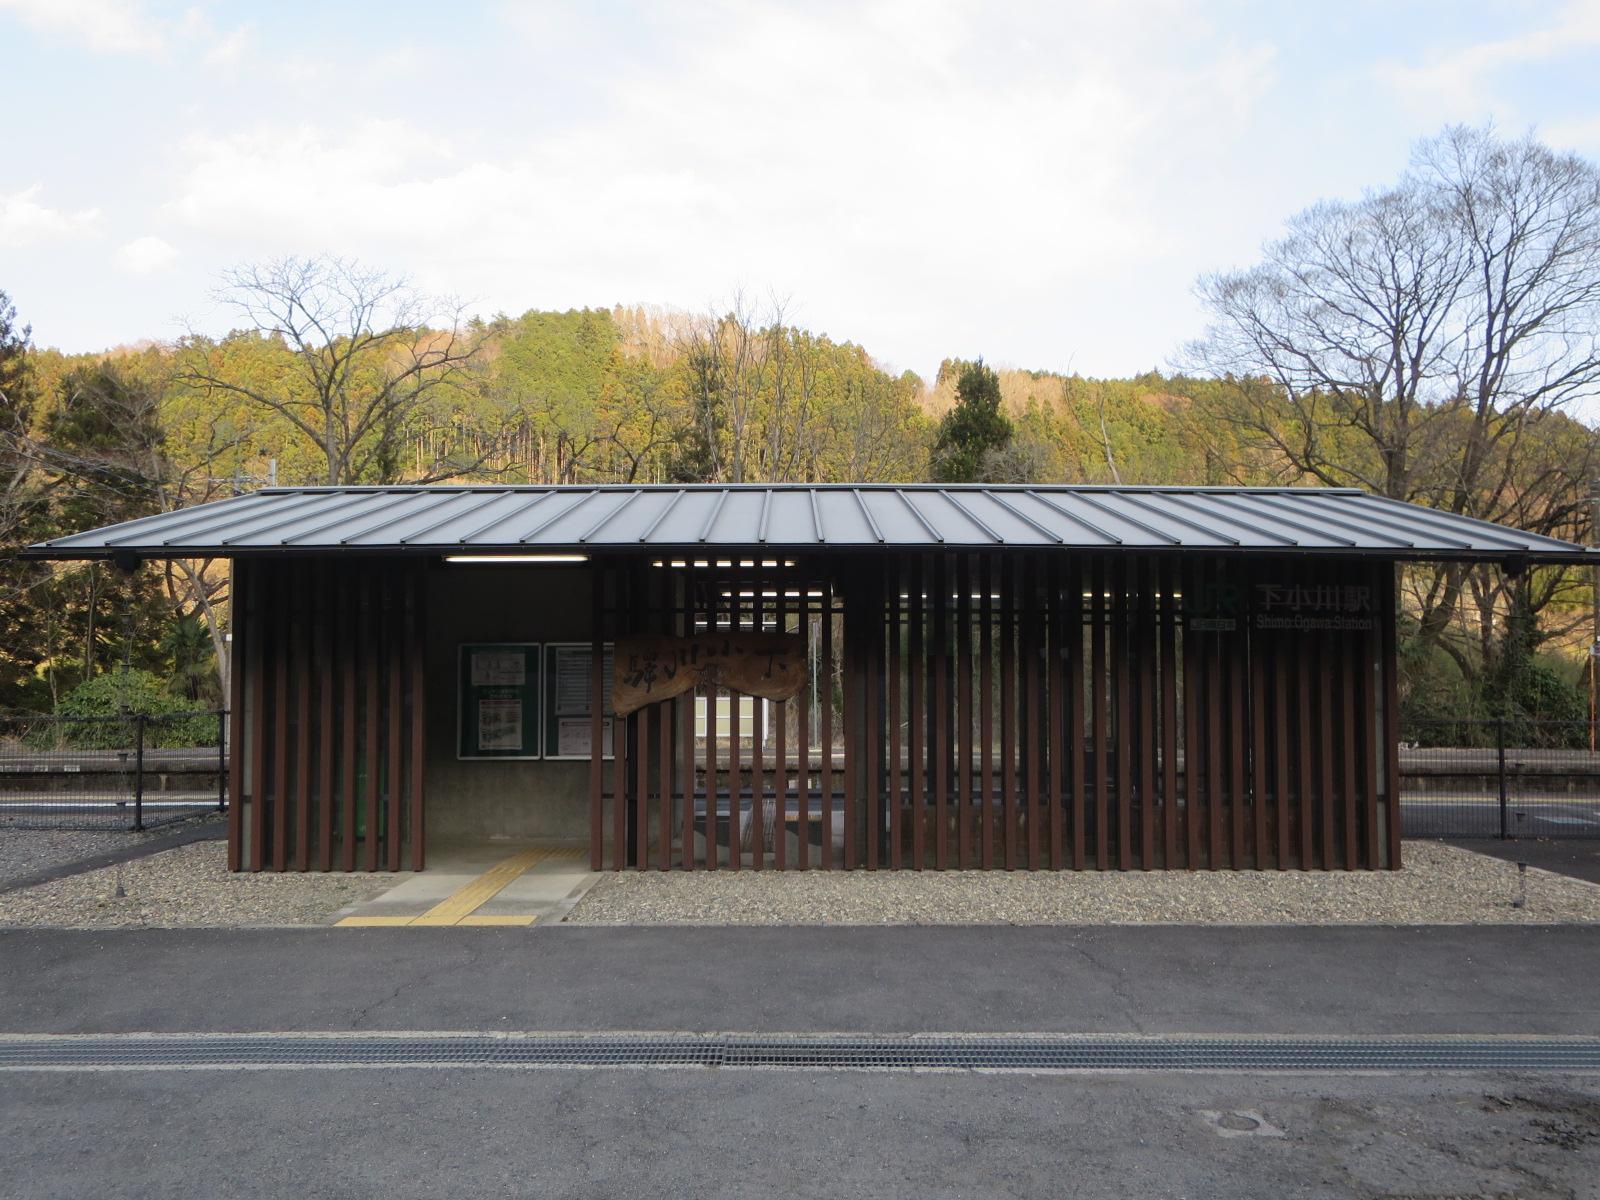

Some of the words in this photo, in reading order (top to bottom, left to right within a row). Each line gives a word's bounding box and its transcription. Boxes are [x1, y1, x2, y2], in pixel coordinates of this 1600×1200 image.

[1256, 584, 1371, 613] 下小川駅
[1334, 614, 1372, 630] Station
